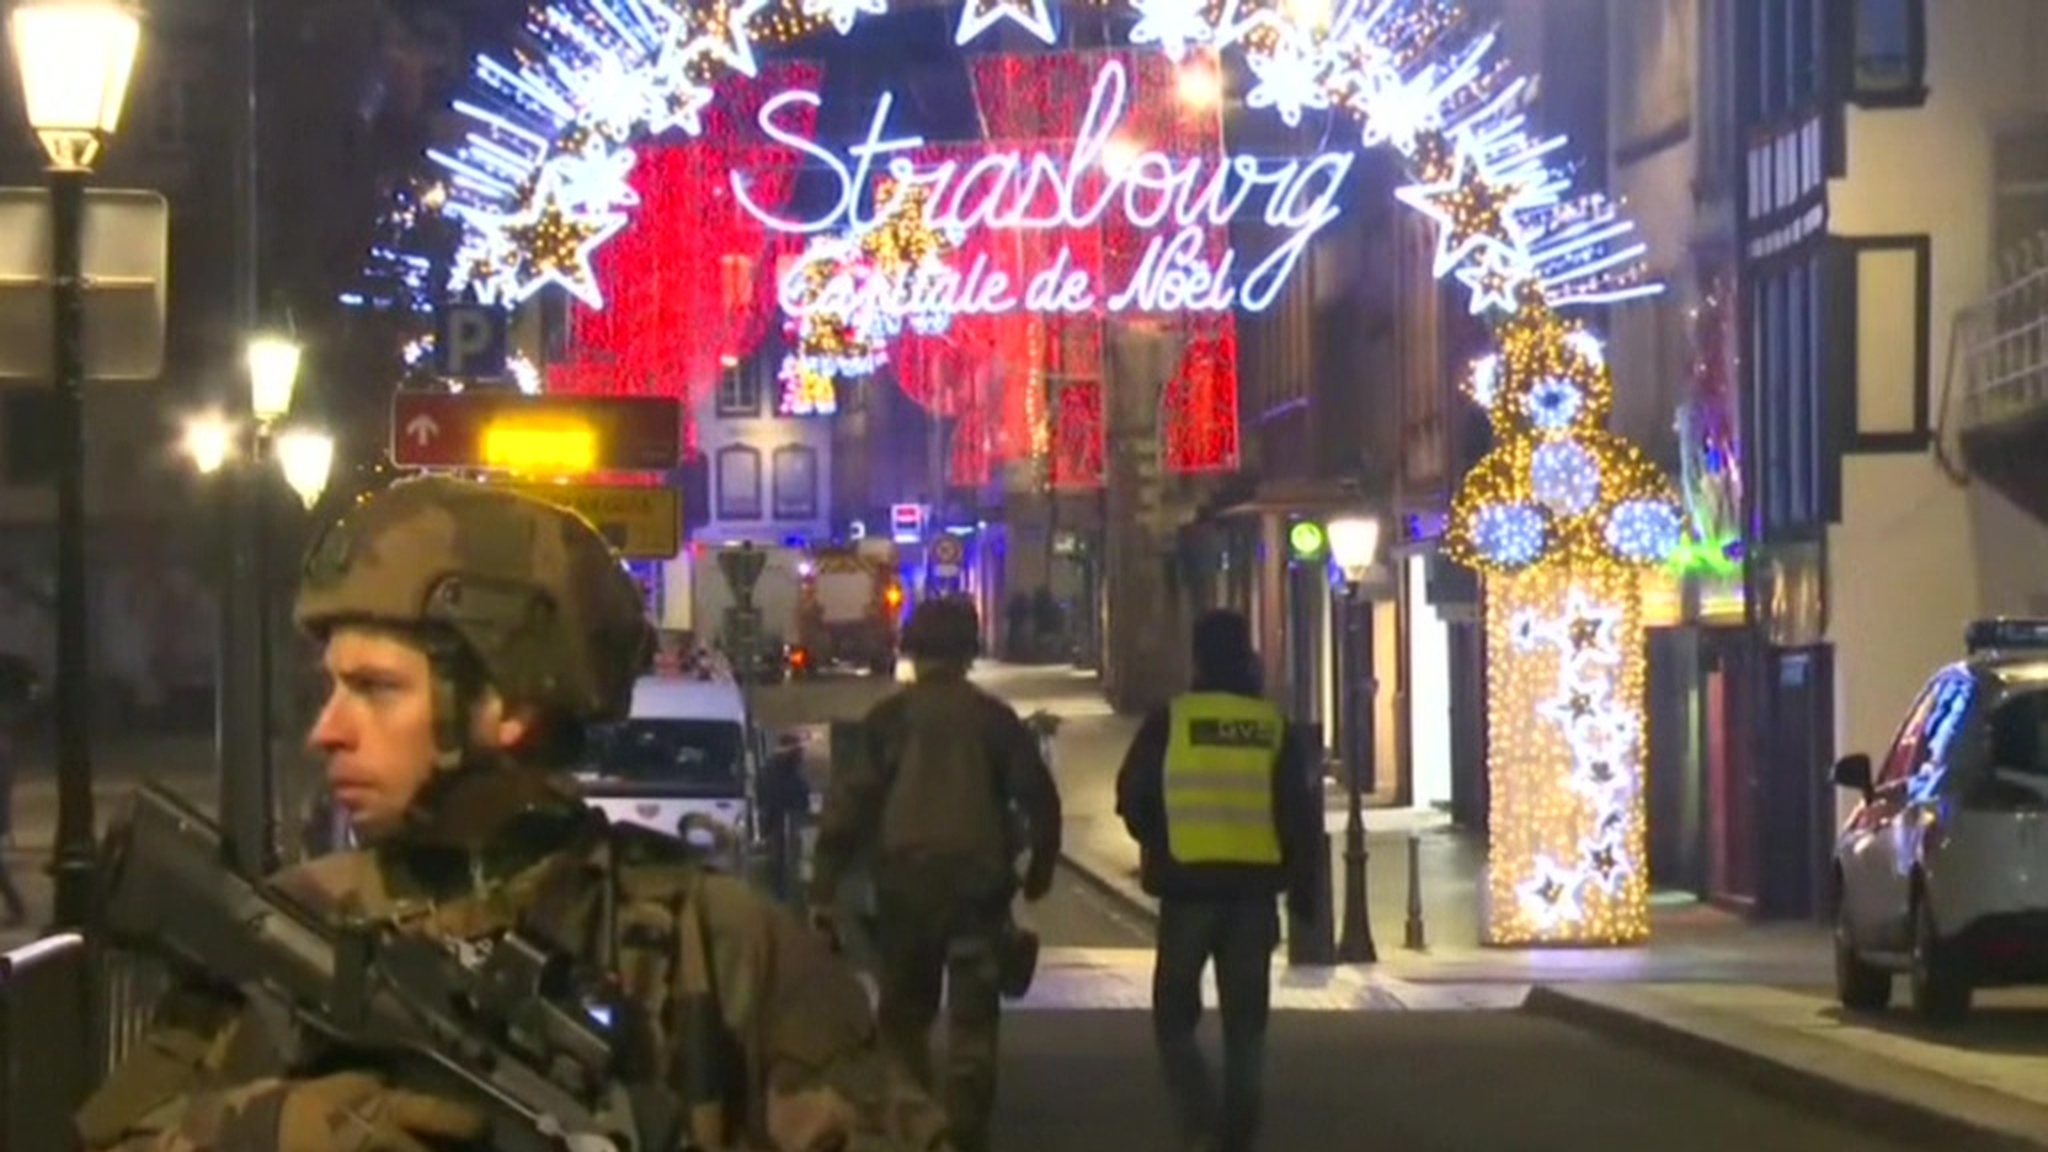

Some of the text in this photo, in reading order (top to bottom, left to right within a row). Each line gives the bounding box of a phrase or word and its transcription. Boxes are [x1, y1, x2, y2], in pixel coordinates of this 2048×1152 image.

[731, 60, 1355, 312] Strasbourg
[778, 225, 1236, 336] Capitale de Noël
[449, 308, 491, 374] P
